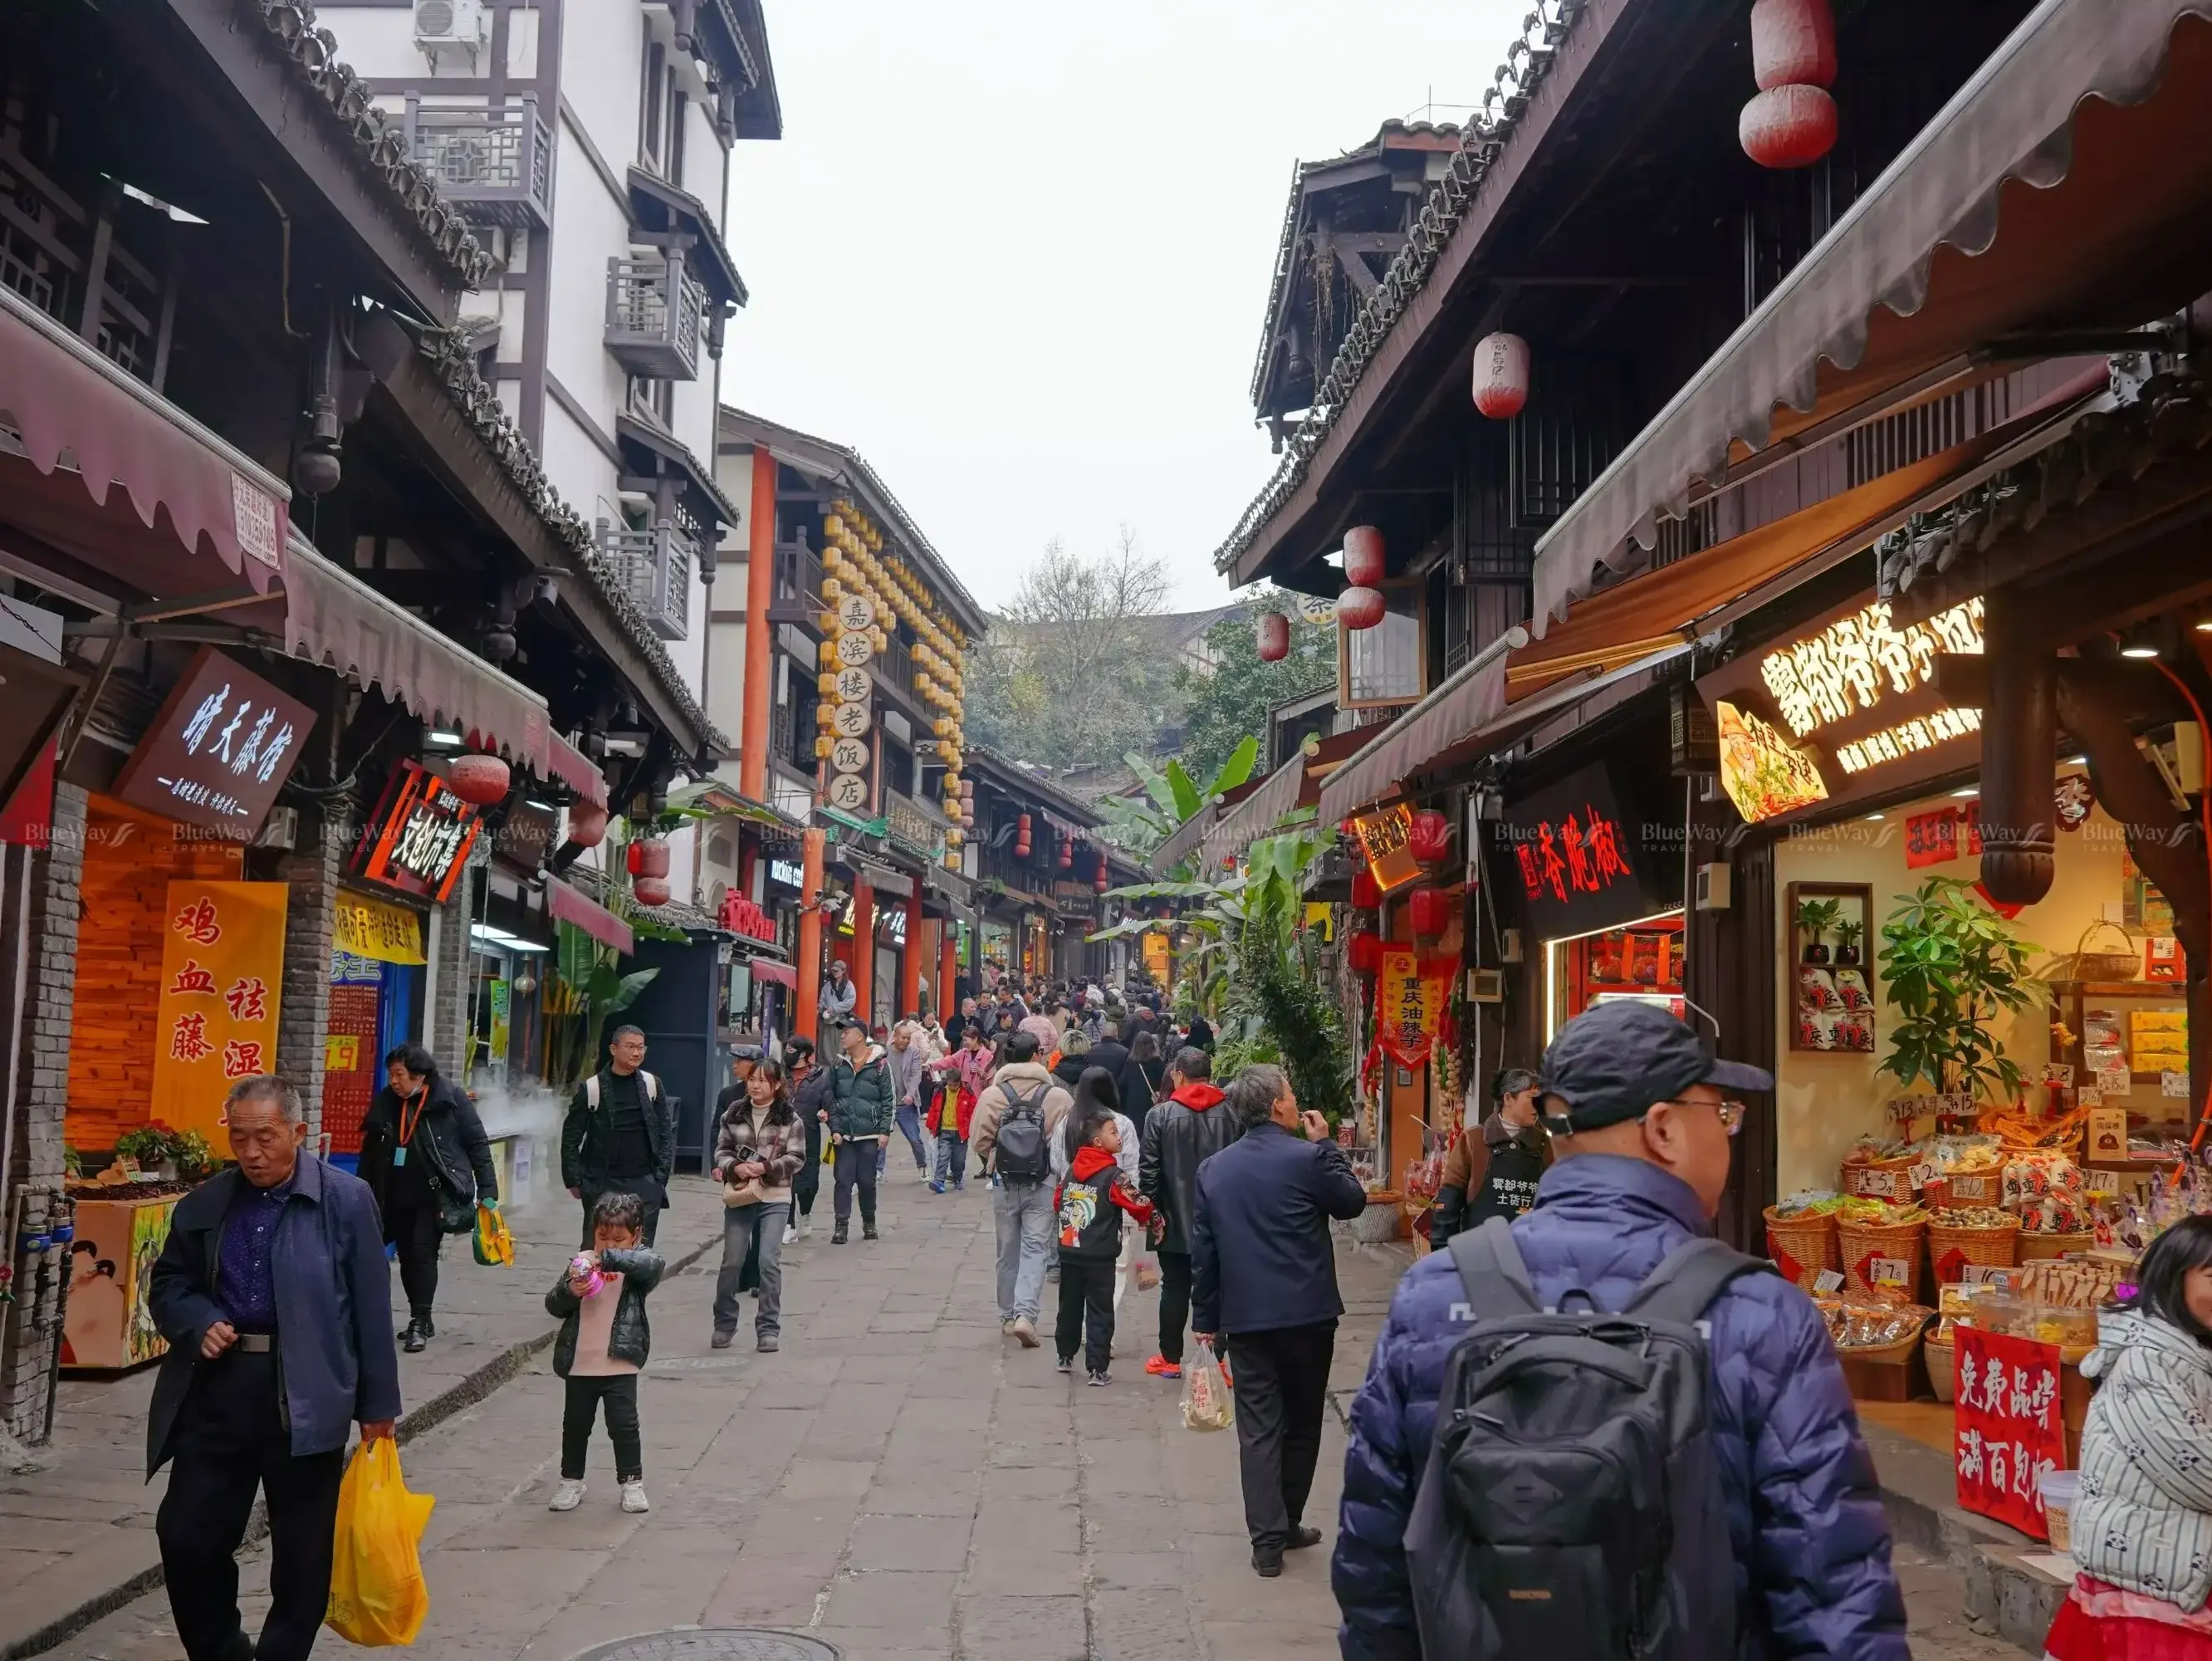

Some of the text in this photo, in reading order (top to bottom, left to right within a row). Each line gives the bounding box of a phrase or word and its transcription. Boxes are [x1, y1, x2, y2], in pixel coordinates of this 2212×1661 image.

[834, 598, 870, 807] 嘉滨楼老饭店
[1760, 595, 1984, 737] 雾都爷爷
[391, 807, 462, 882] 文创市集
[771, 860, 792, 884] luckin
[170, 896, 222, 1062] 鸡血藤
[1400, 977, 1424, 1048] 重庆油辣子
[222, 978, 268, 1126] 祛湿
[1492, 1178, 1539, 1193] 雾都爷爷
[1497, 1193, 1531, 1208] 土货行
[1960, 1350, 2055, 1430] 免费品尝
[1958, 1428, 2057, 1513] 满百包邮
